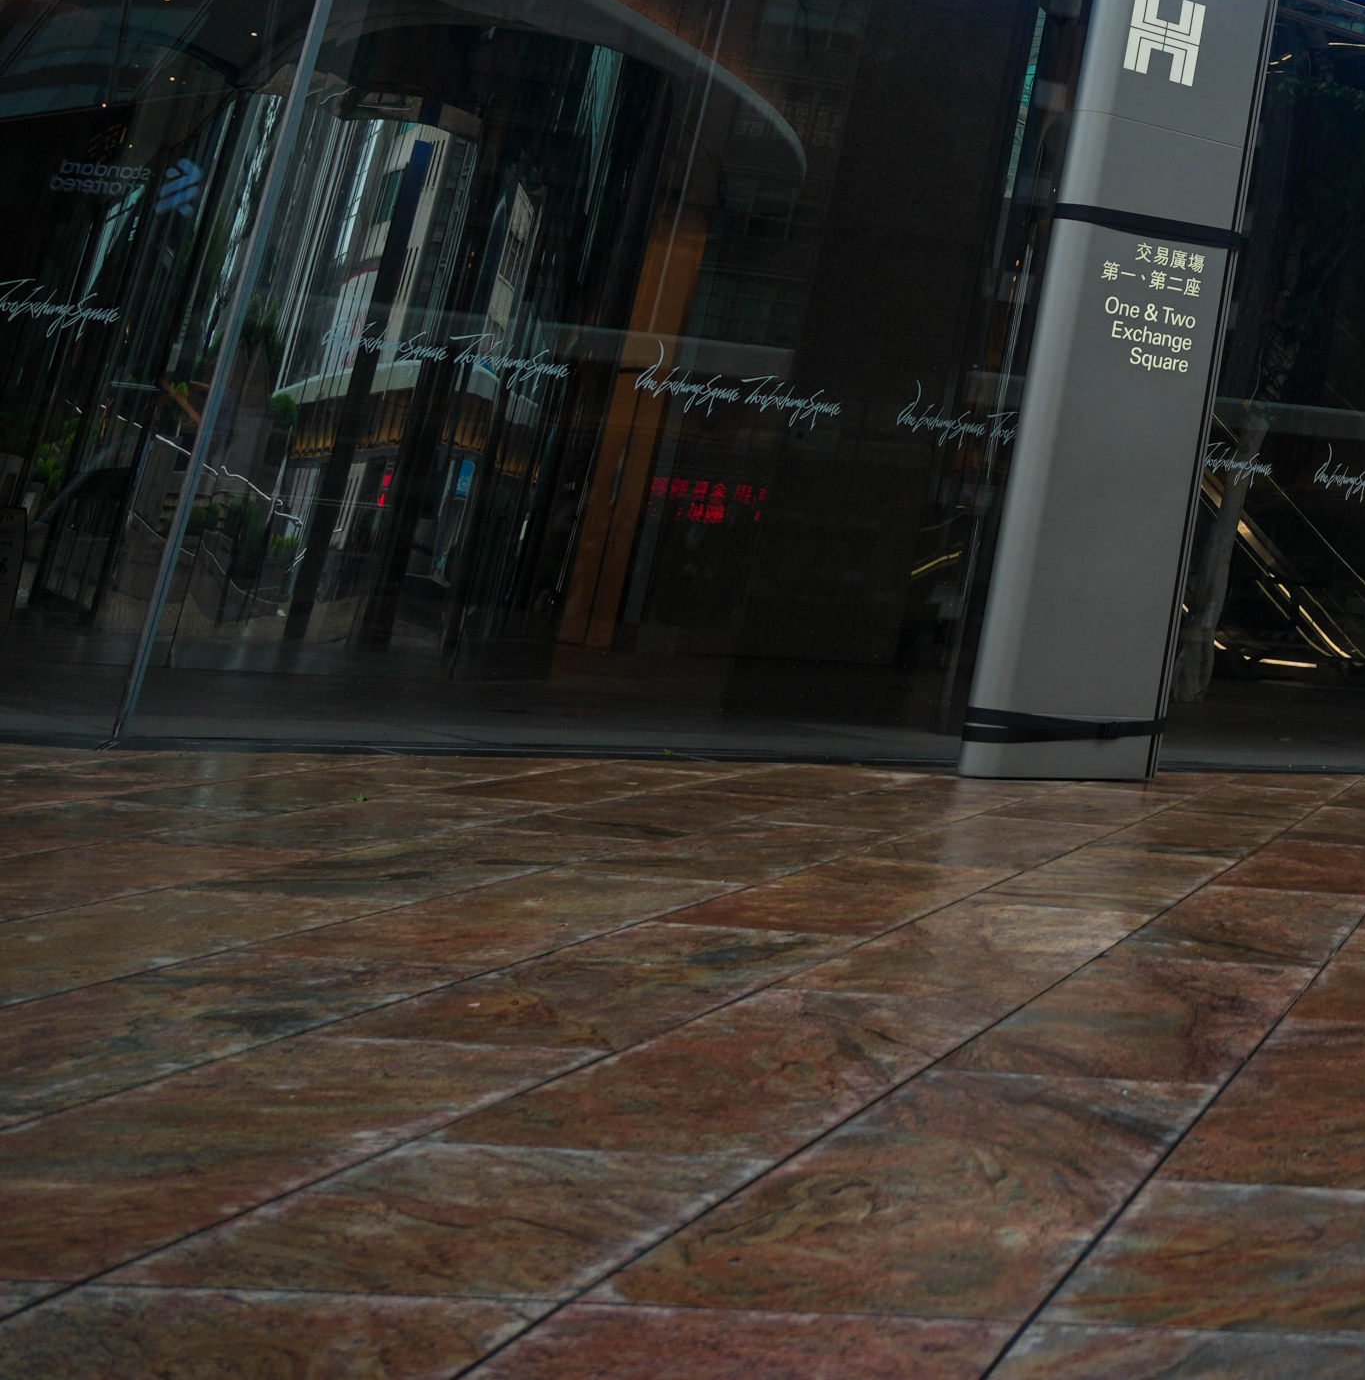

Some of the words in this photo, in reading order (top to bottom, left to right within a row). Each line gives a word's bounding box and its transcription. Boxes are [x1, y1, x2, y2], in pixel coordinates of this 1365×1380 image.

[1105, 295, 1141, 321] One
[1144, 303, 1159, 322] &
[1163, 306, 1197, 330] Two
[1111, 322, 1193, 352] Exchange
[1130, 346, 1189, 373] Square
